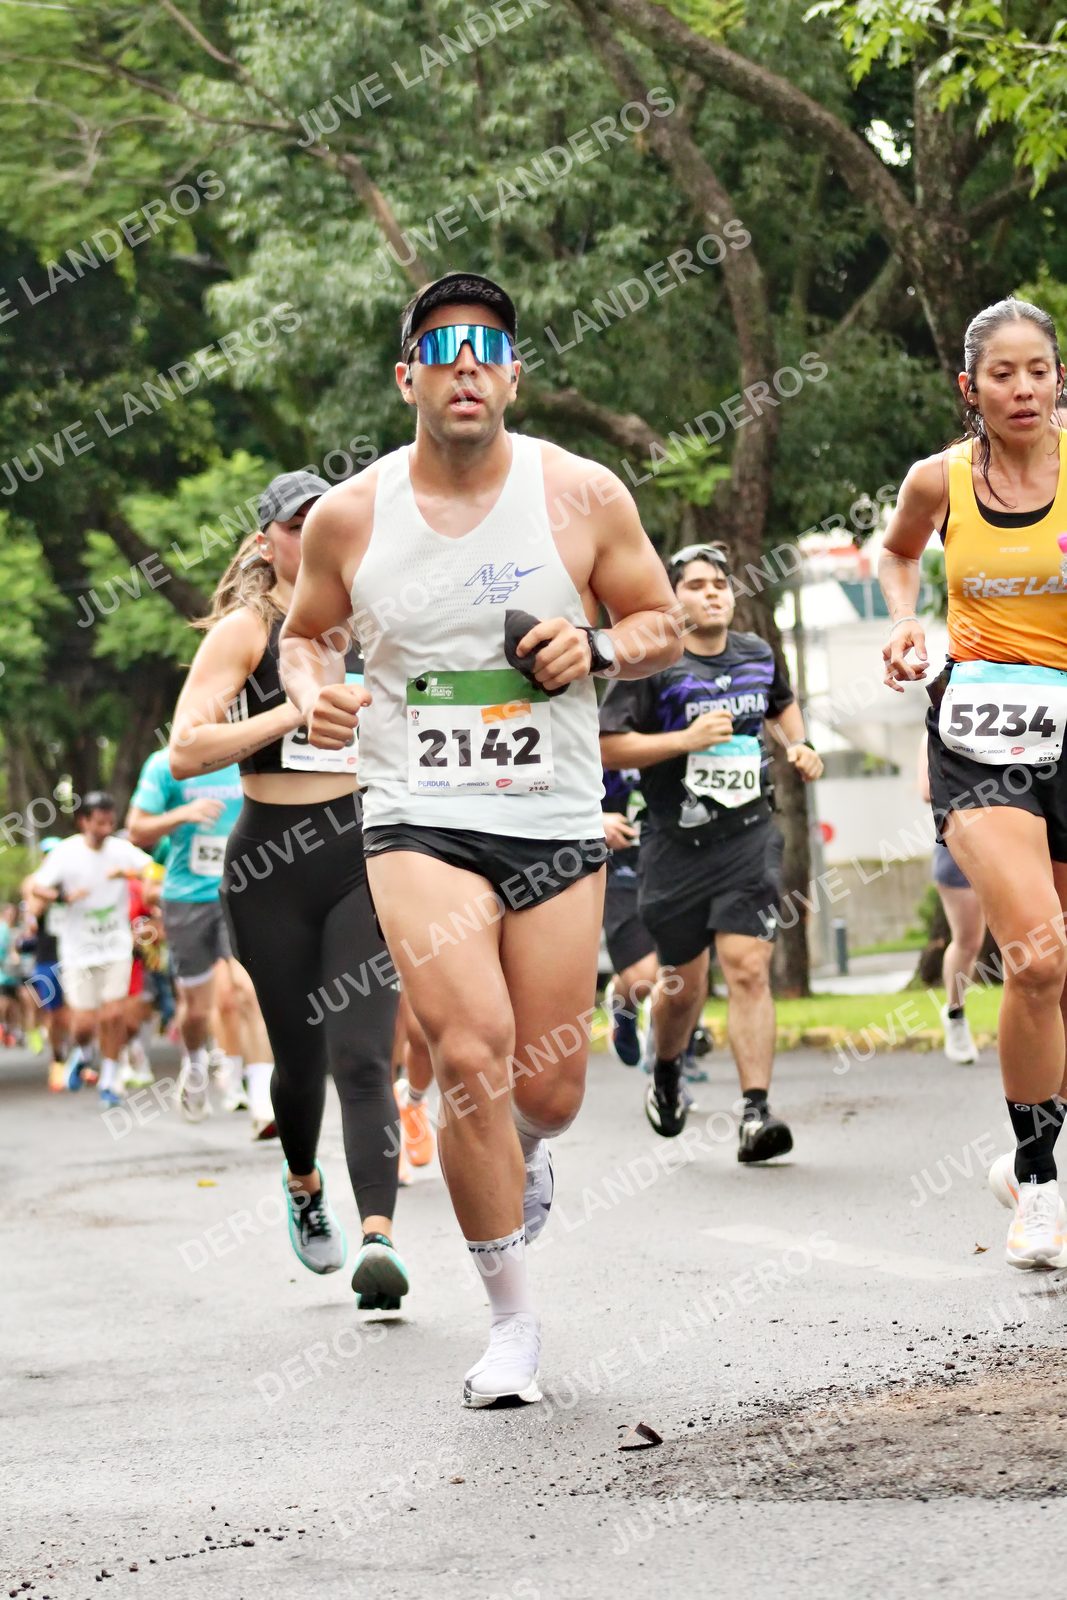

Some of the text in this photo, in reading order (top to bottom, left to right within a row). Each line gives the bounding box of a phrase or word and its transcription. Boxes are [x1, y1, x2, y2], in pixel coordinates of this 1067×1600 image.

[962, 572, 1025, 598] RISE
[947, 703, 1056, 738] 5234
[418, 727, 541, 767] 2142
[694, 768, 755, 790] 2520
